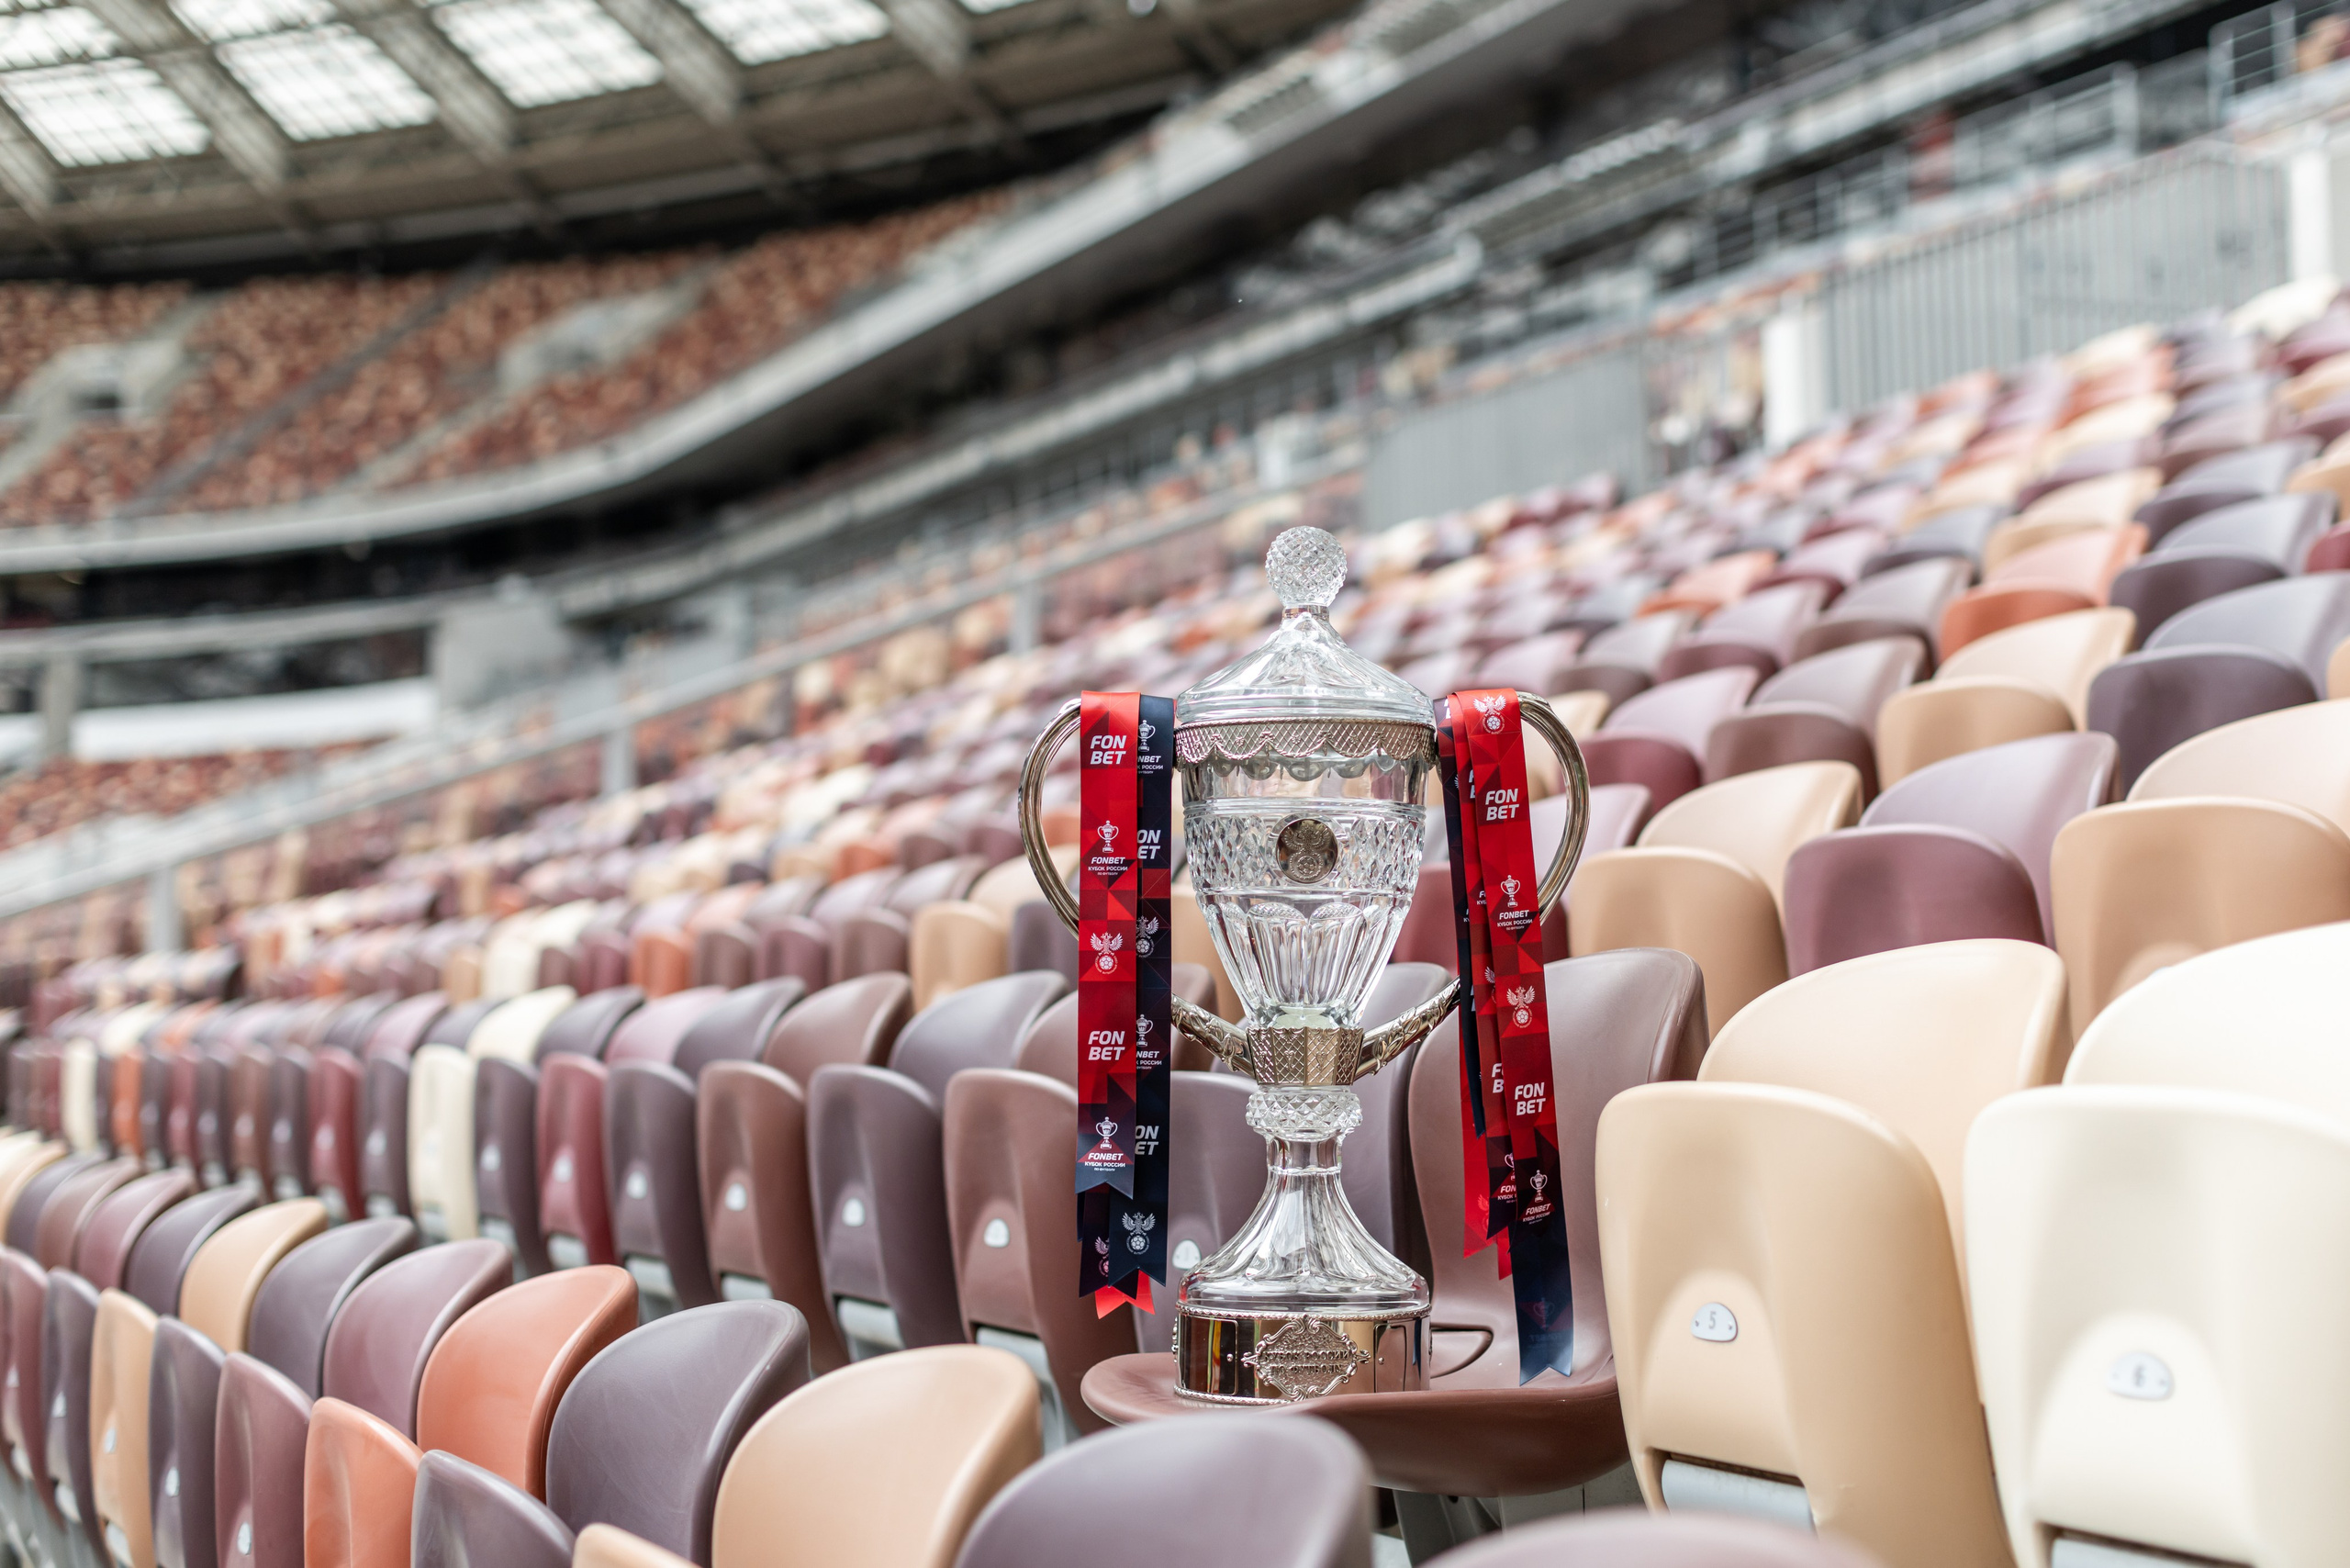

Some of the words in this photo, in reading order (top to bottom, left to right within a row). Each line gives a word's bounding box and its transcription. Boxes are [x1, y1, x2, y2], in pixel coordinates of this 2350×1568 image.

[1090, 734, 1127, 749] FON
[1090, 750, 1127, 765] BET
[1137, 755, 1162, 763] NBET
[1484, 788, 1519, 805] FON
[1486, 803, 1520, 821] BET
[1136, 829, 1161, 844] ON
[1136, 845, 1161, 859] ET
[1091, 857, 1126, 865] FONBET
[1498, 909, 1530, 921] FONBET
[1513, 918, 1533, 926] РОССИИ
[1088, 1030, 1125, 1045] FON
[1088, 1046, 1125, 1061] BET
[1136, 1050, 1160, 1058] NBET
[1514, 1081, 1545, 1101] FON
[1516, 1097, 1547, 1116] BET
[1135, 1125, 1159, 1139] ON
[1134, 1140, 1159, 1156] ET
[1087, 1152, 1124, 1161] FONBET
[1500, 1184, 1516, 1193] FON
[1525, 1203, 1551, 1215] FONBET
[1708, 1310, 1717, 1330] 5
[1303, 1350, 1349, 1361] РОССИИ
